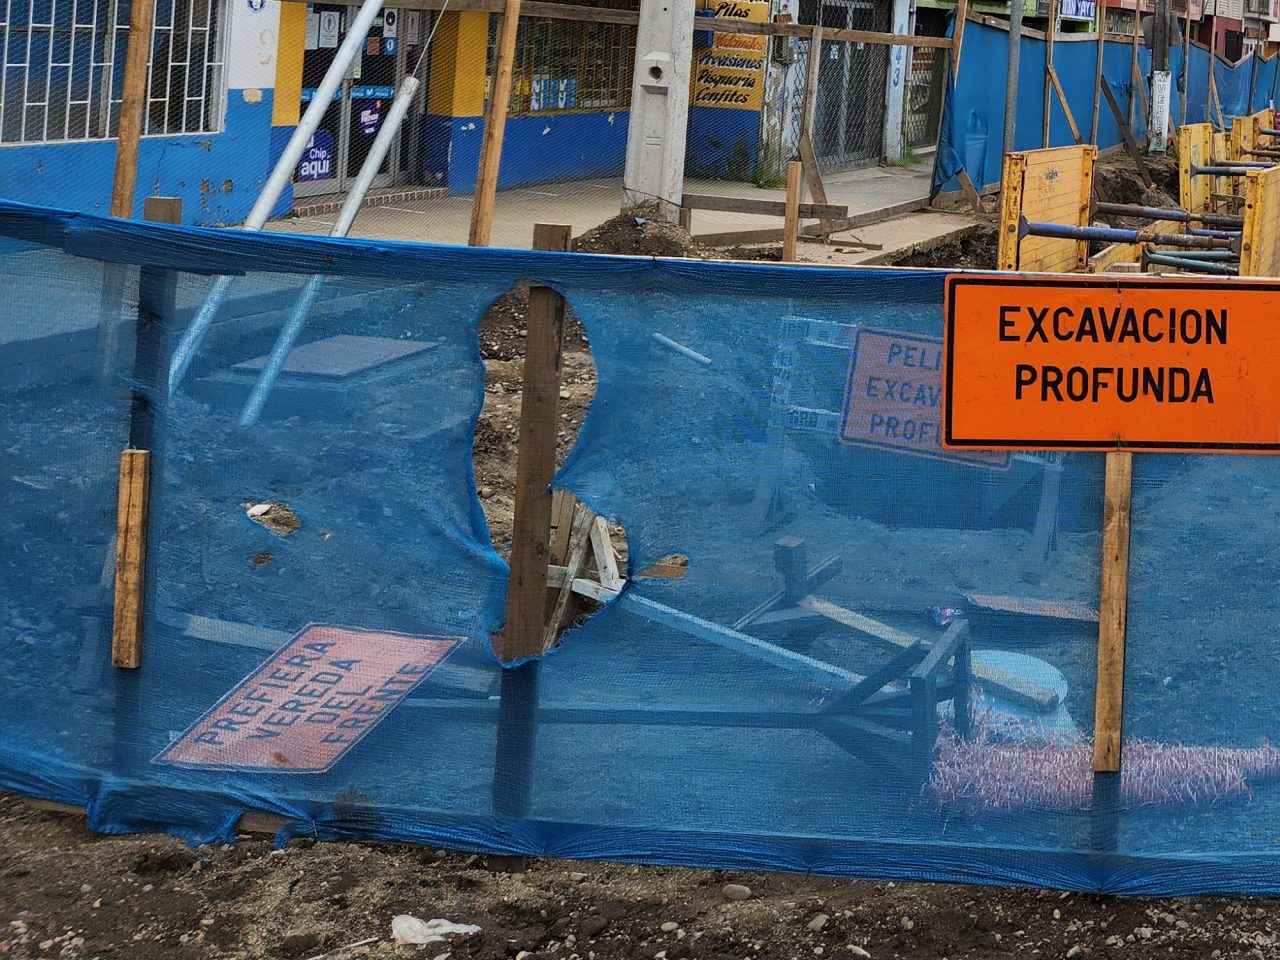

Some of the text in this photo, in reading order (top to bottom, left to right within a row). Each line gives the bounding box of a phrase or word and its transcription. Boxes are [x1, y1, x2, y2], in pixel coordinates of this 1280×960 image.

[714, 1, 752, 19] Pilas
[700, 51, 763, 70] Provisiones
[696, 88, 750, 107] Confites
[1156, 72, 1167, 148] MUEBLES
[309, 148, 327, 161] Chip
[999, 305, 1228, 345] EXCAVACION
[1014, 363, 1215, 404] PROFUNDA
[193, 640, 337, 746] PREFIERA
[246, 658, 362, 741] VEREDA
[304, 685, 373, 724] DEL
[320, 662, 425, 745] FRENTE
